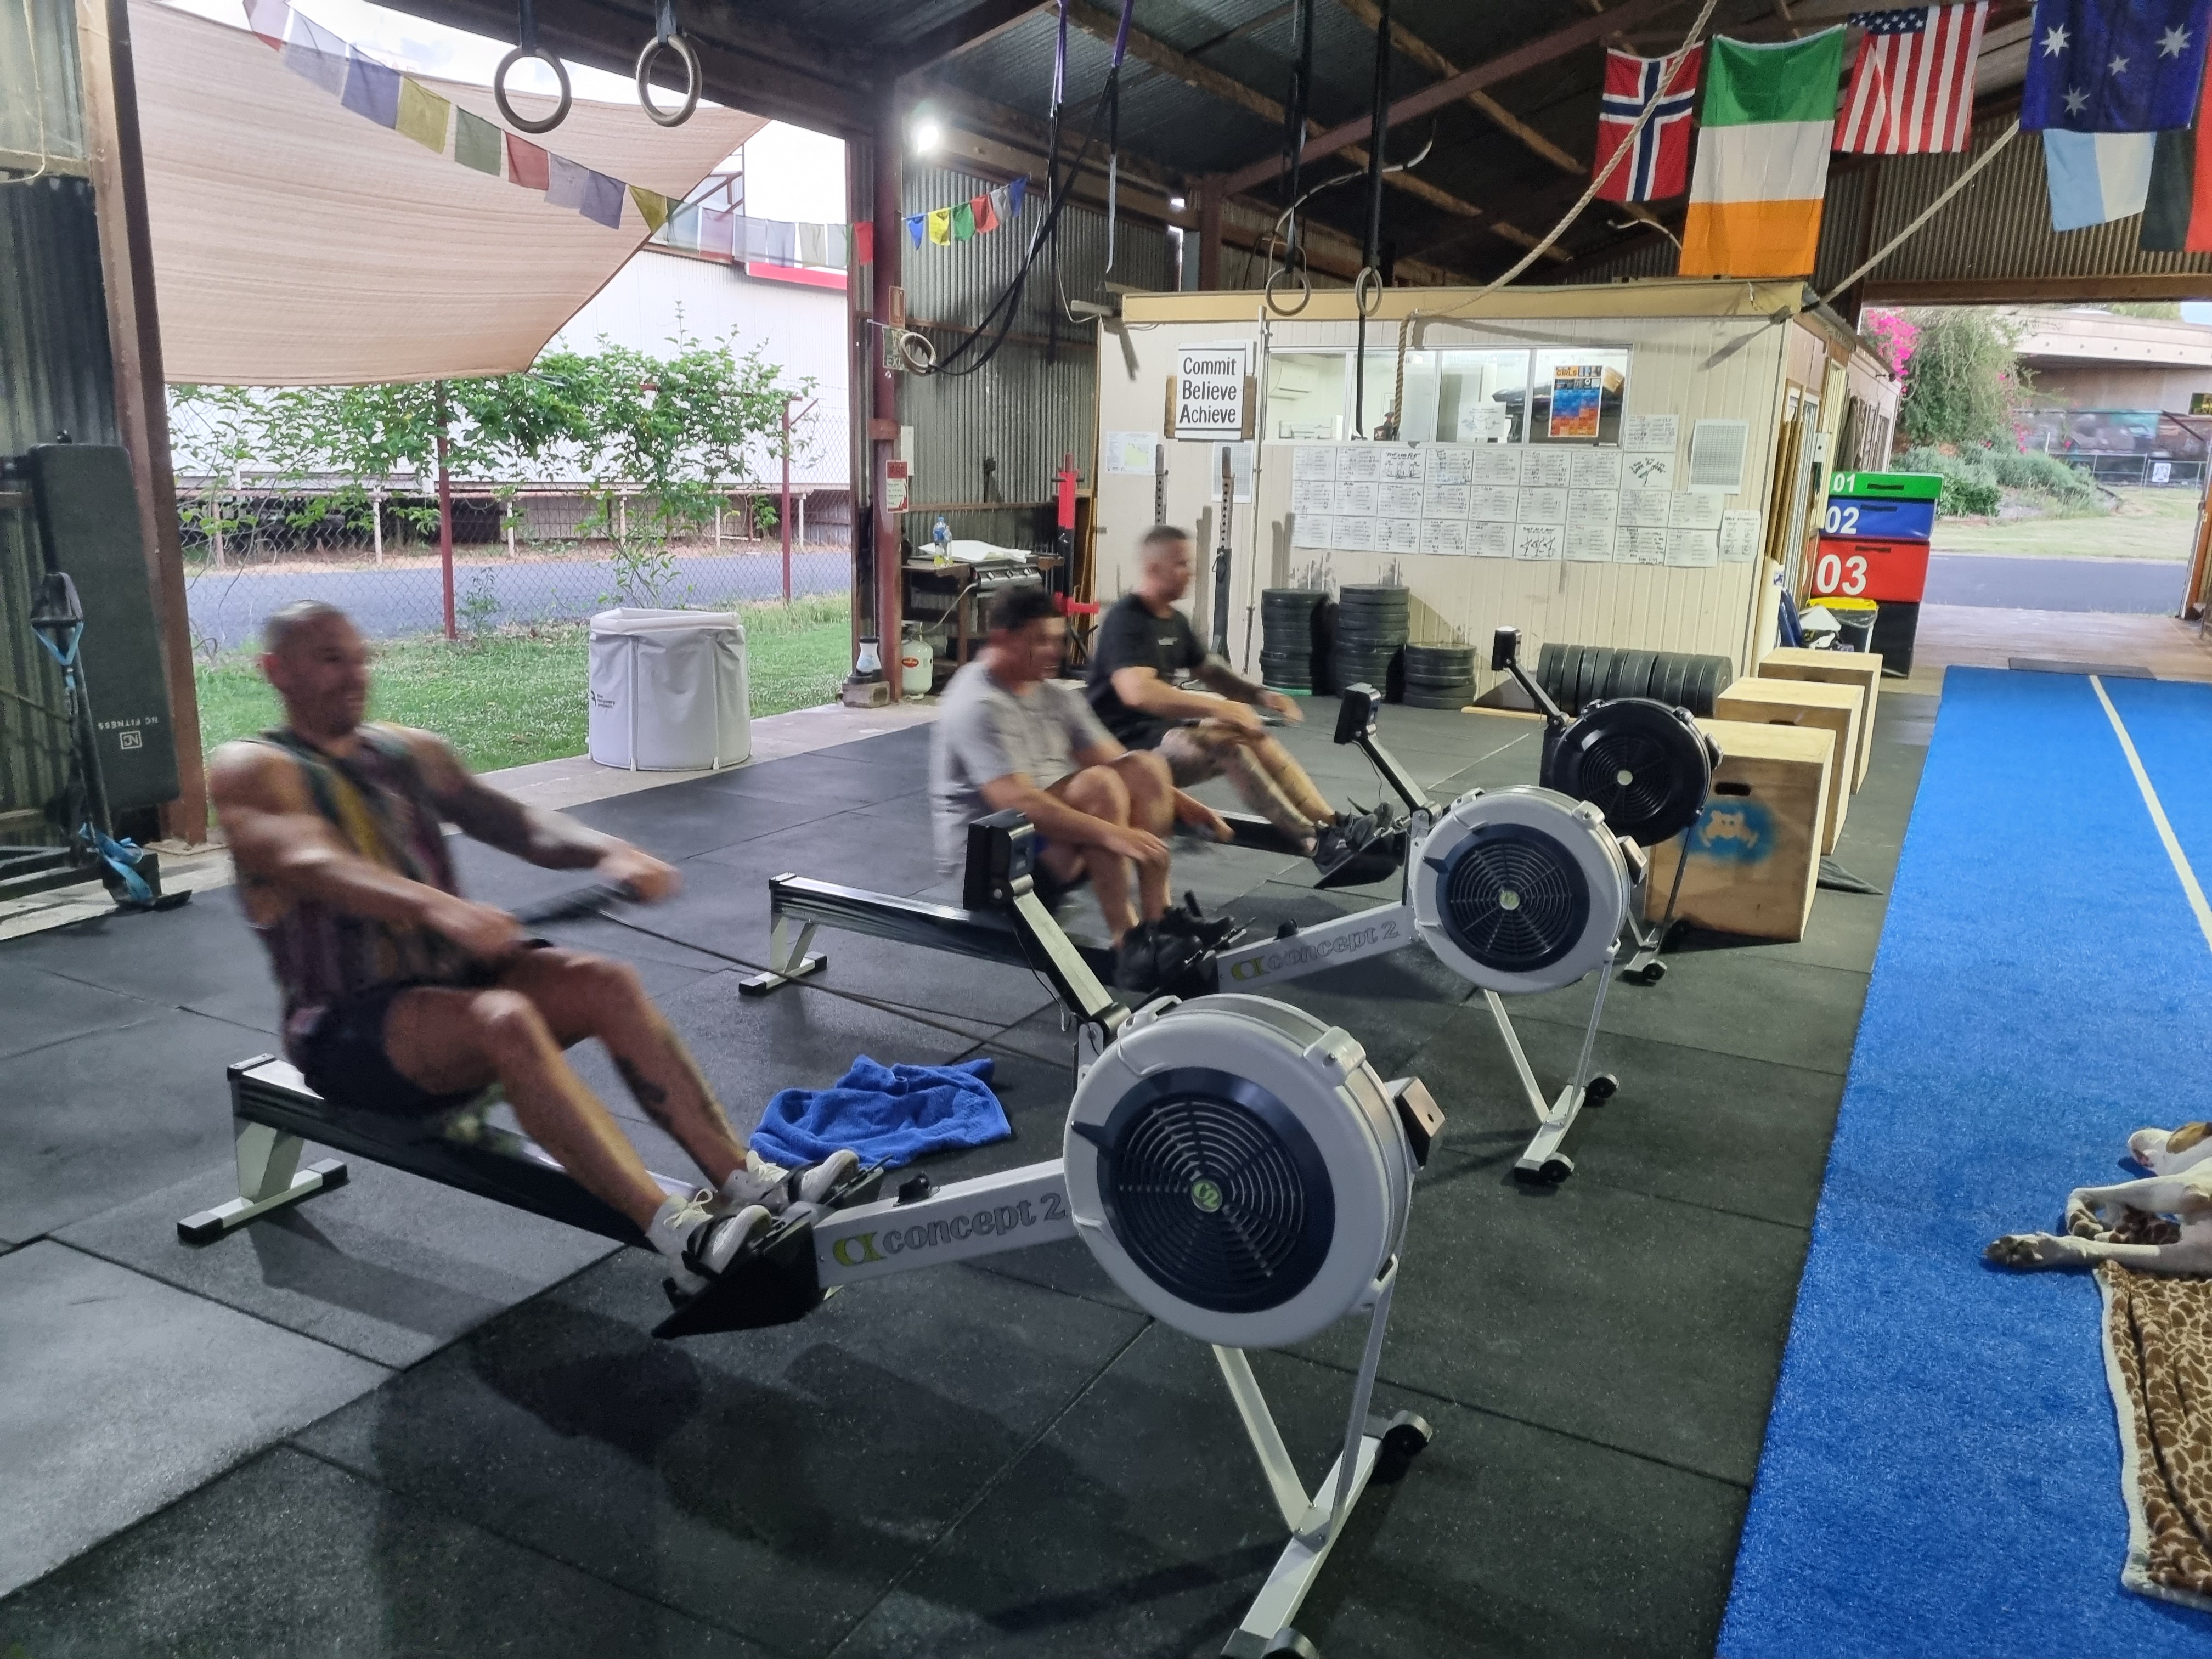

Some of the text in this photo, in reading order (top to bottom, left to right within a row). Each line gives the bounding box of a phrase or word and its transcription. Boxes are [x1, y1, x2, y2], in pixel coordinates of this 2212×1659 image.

[1183, 357, 1237, 376] Commit
[1182, 380, 1237, 401] Believe
[1179, 404, 1237, 424] Achieve
[1833, 473, 1856, 493] 01
[1825, 506, 1860, 534] 02
[1816, 554, 1868, 595] 03
[98, 718, 141, 730] FITNESS
[1268, 921, 1401, 970] concept 2
[883, 1192, 1066, 1255] concept 2
